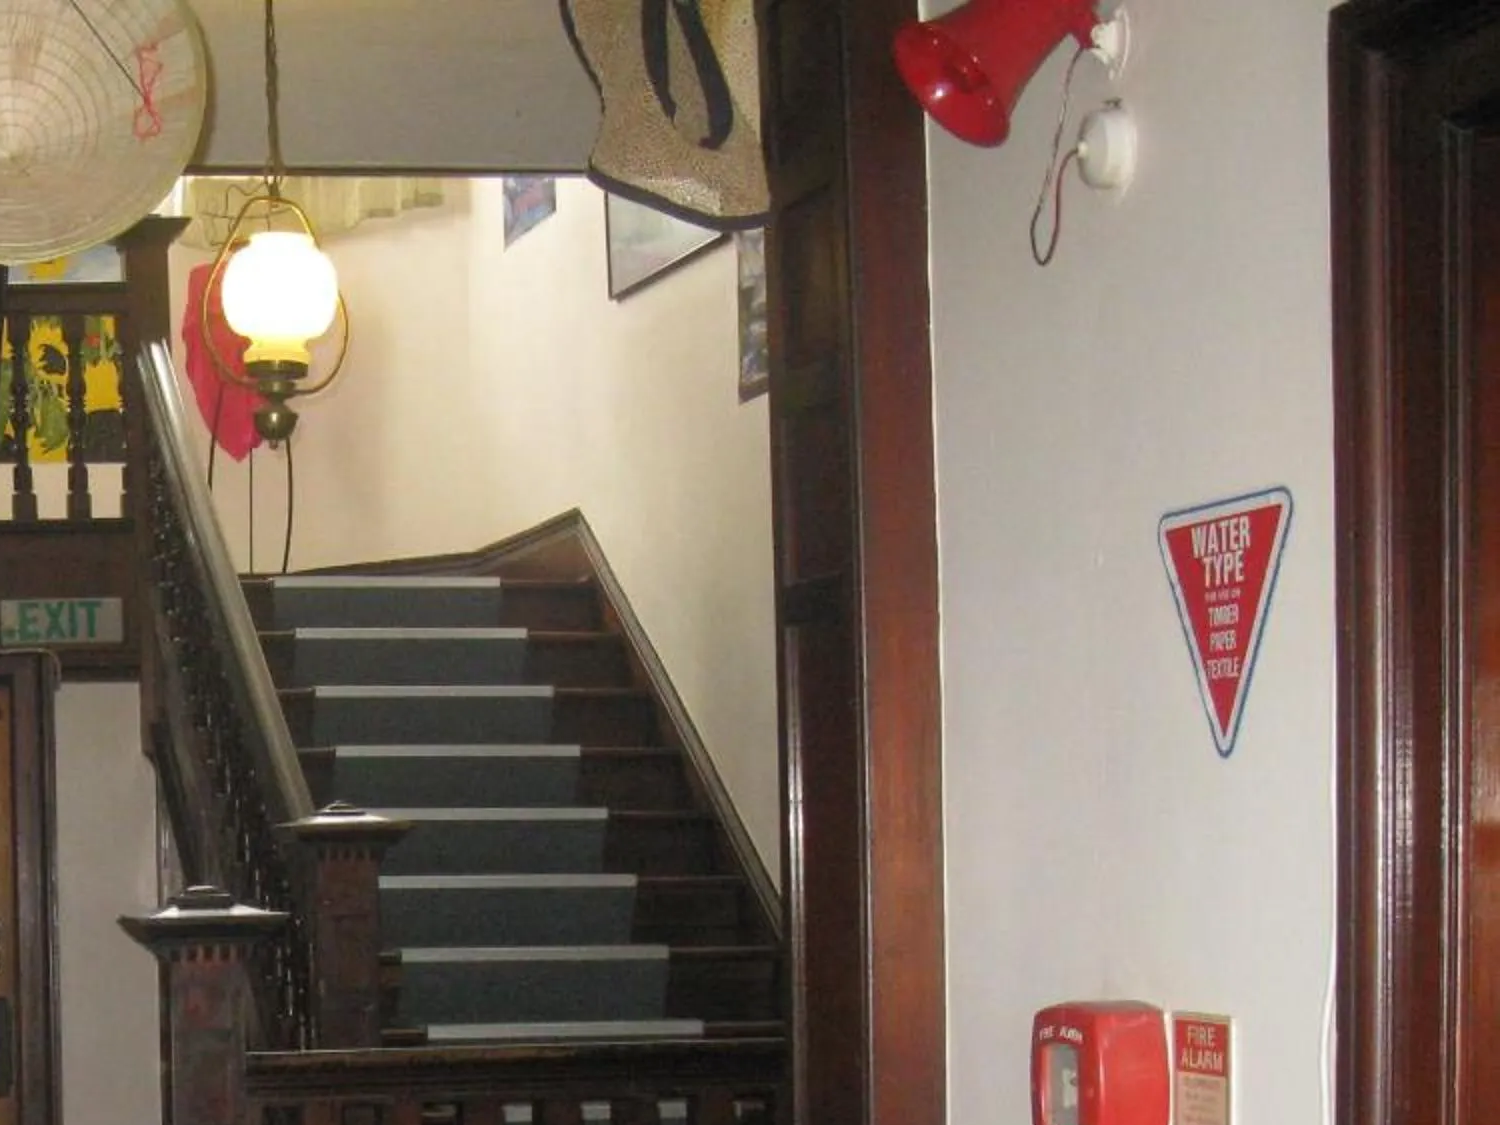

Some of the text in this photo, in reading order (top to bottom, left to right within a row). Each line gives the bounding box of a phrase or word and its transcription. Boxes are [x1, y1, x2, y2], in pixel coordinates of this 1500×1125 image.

[1191, 515, 1251, 559] WATER
[1203, 550, 1245, 588] TYPE
[17, 602, 103, 641] EXIT
[1187, 1025, 1216, 1048] FIRE
[1180, 1047, 1224, 1073] ALARM
